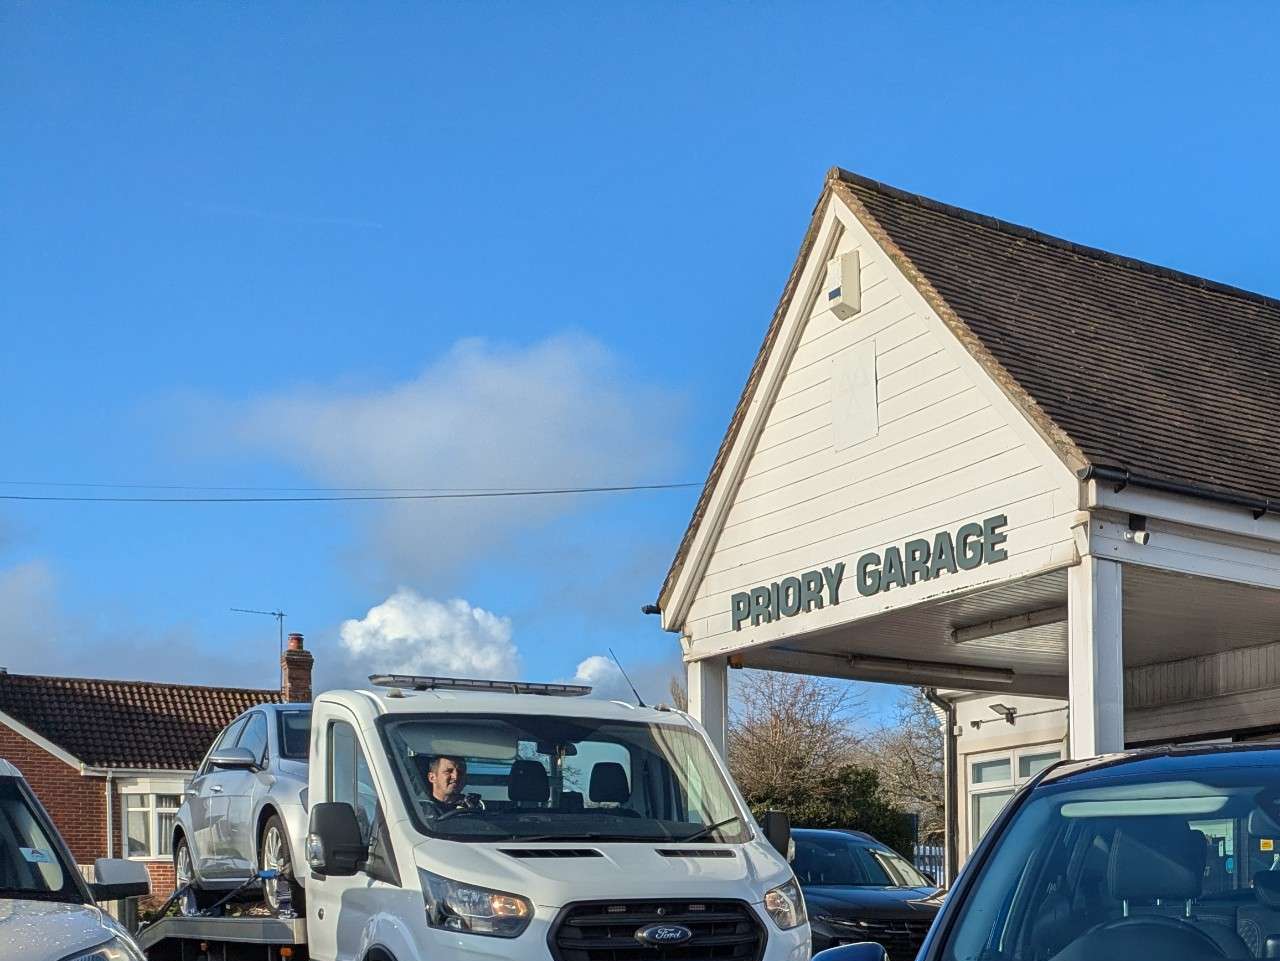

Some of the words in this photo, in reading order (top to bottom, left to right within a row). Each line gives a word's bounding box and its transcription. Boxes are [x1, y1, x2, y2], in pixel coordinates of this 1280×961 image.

[731, 562, 846, 631] PRIORY
[857, 514, 1008, 597] GARAGE
[655, 927, 682, 940] Ford
